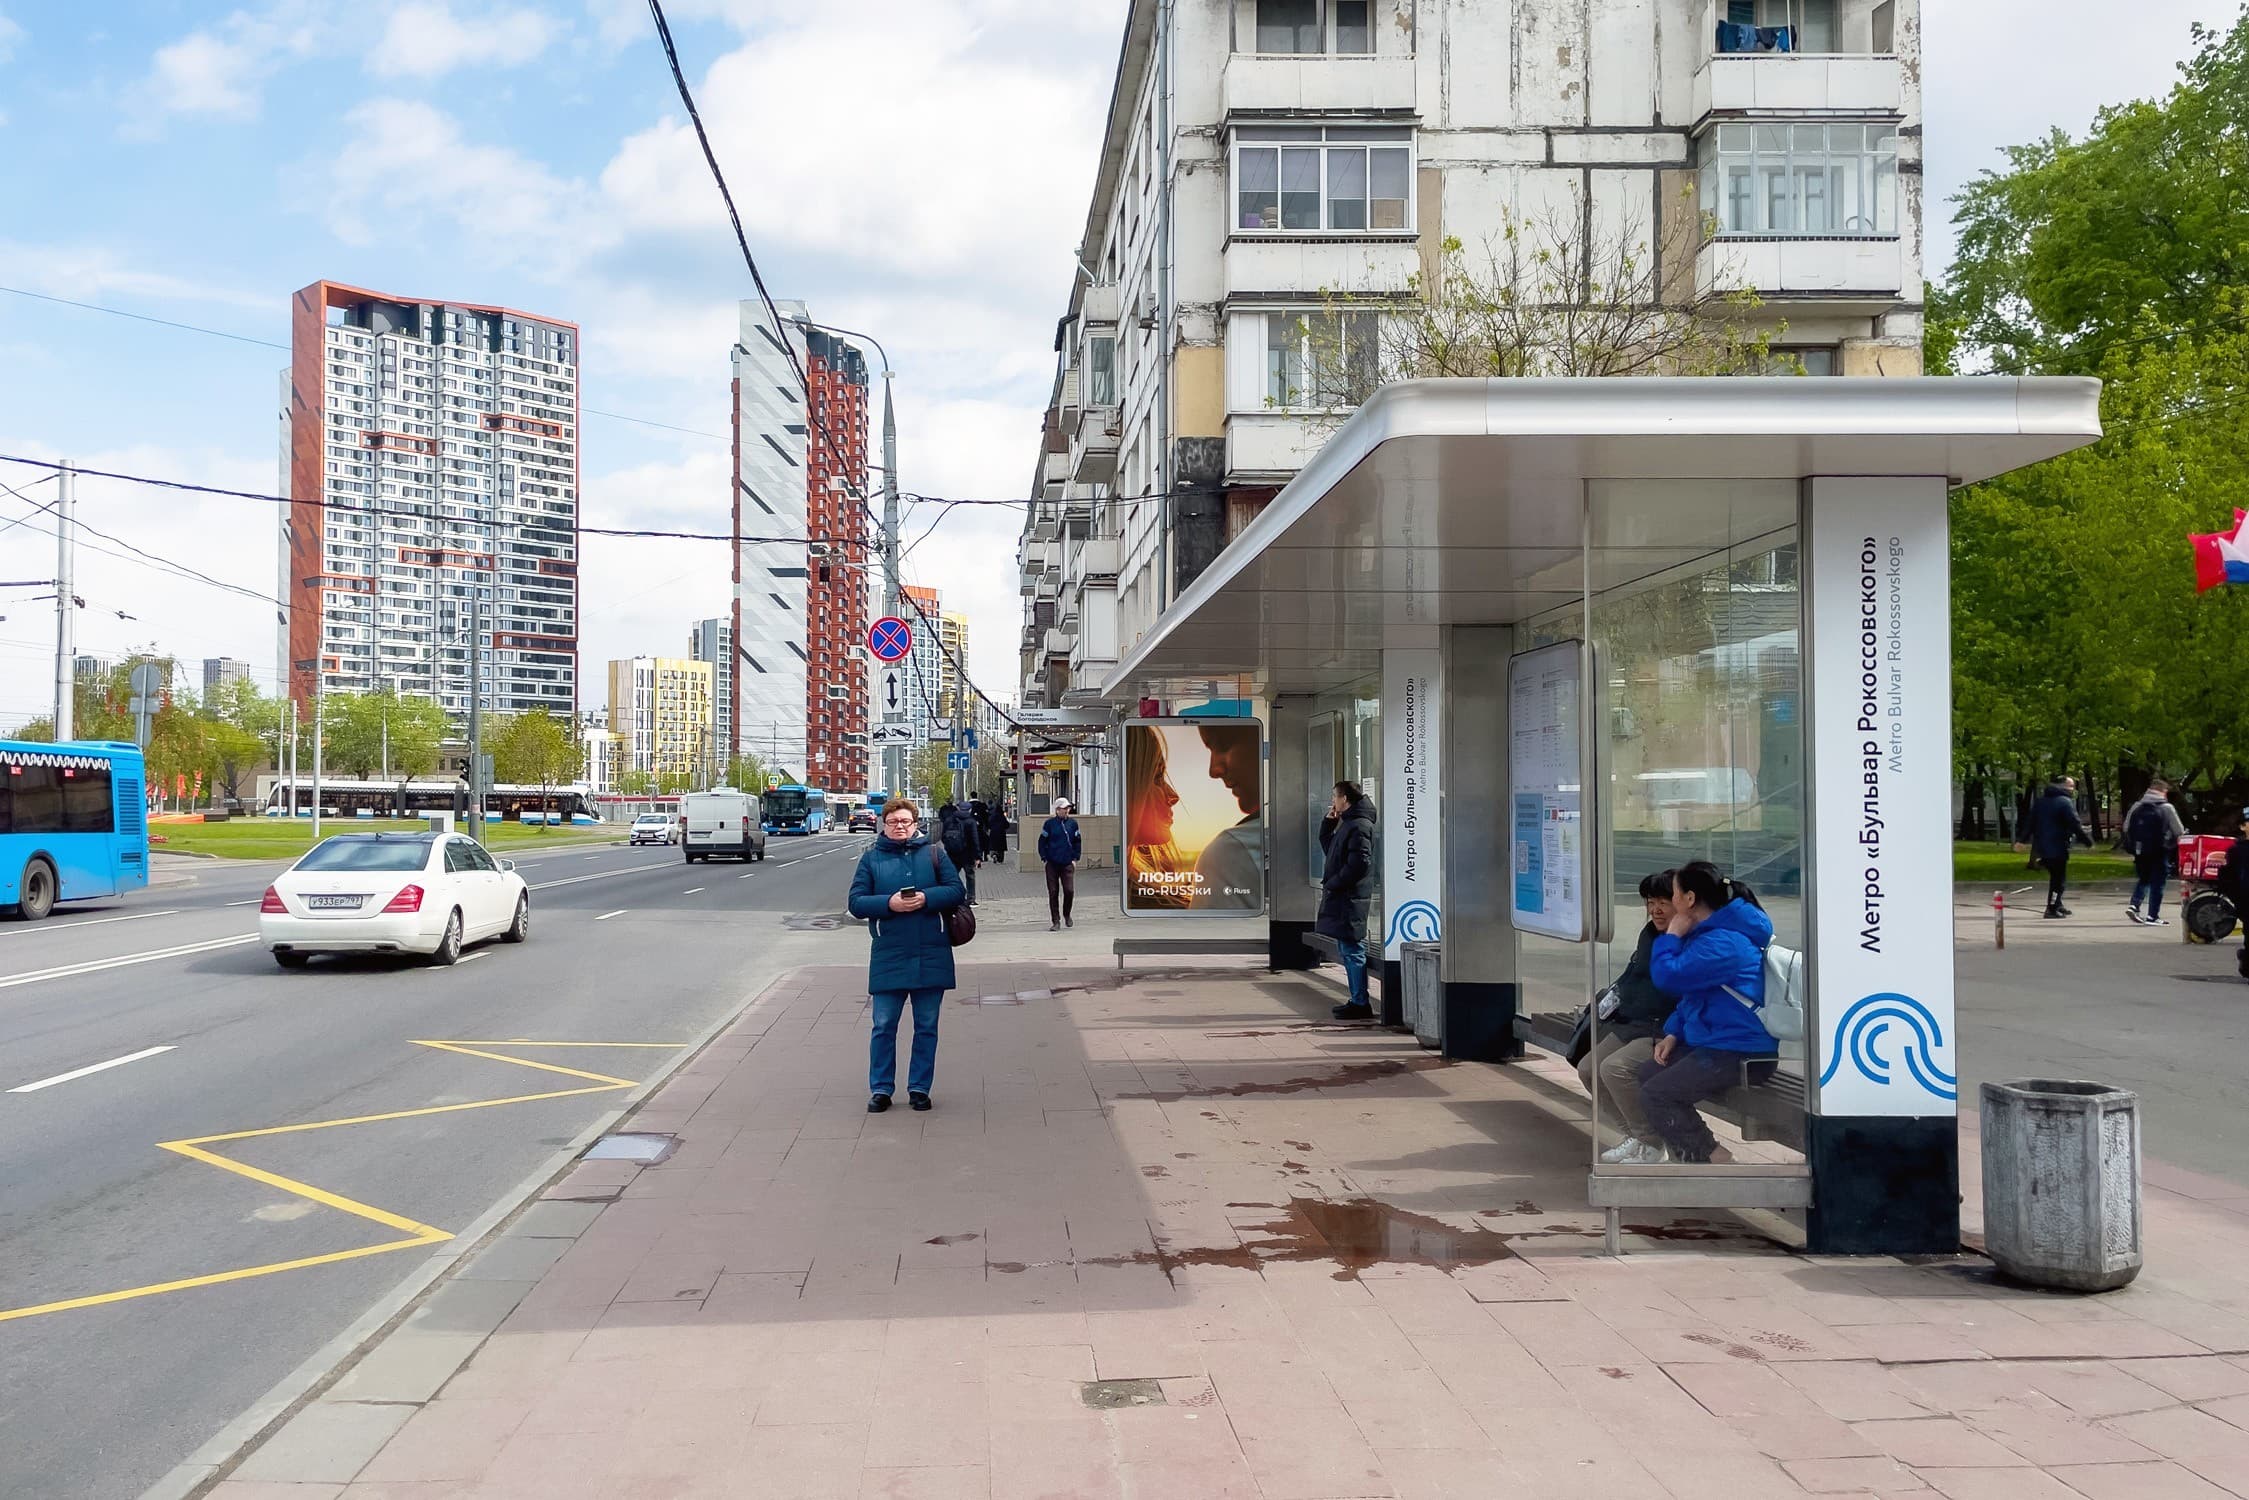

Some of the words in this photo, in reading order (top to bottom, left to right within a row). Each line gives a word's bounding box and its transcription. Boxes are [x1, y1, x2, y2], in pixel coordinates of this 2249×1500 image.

[1886, 536, 1904, 661] Rokossovskogo
[1857, 536, 1878, 731] Рокоссовского»
[1887, 667, 1902, 717] Bulvar
[1403, 678, 1415, 774] Рокоссовского»
[1888, 722, 1903, 773] Metro
[1418, 742, 1427, 767] Bulvar
[1404, 777, 1418, 836] «Бульвар
[1418, 769, 1427, 794] Metro
[1859, 740, 1884, 859] «Бульвар
[1137, 871, 1205, 883] ЛЮБИТЬ
[1404, 839, 1418, 882] Метро
[1138, 885, 1212, 896] по-RUSSки
[1233, 887, 1251, 895] Russ
[1860, 867, 1885, 954] Метро
